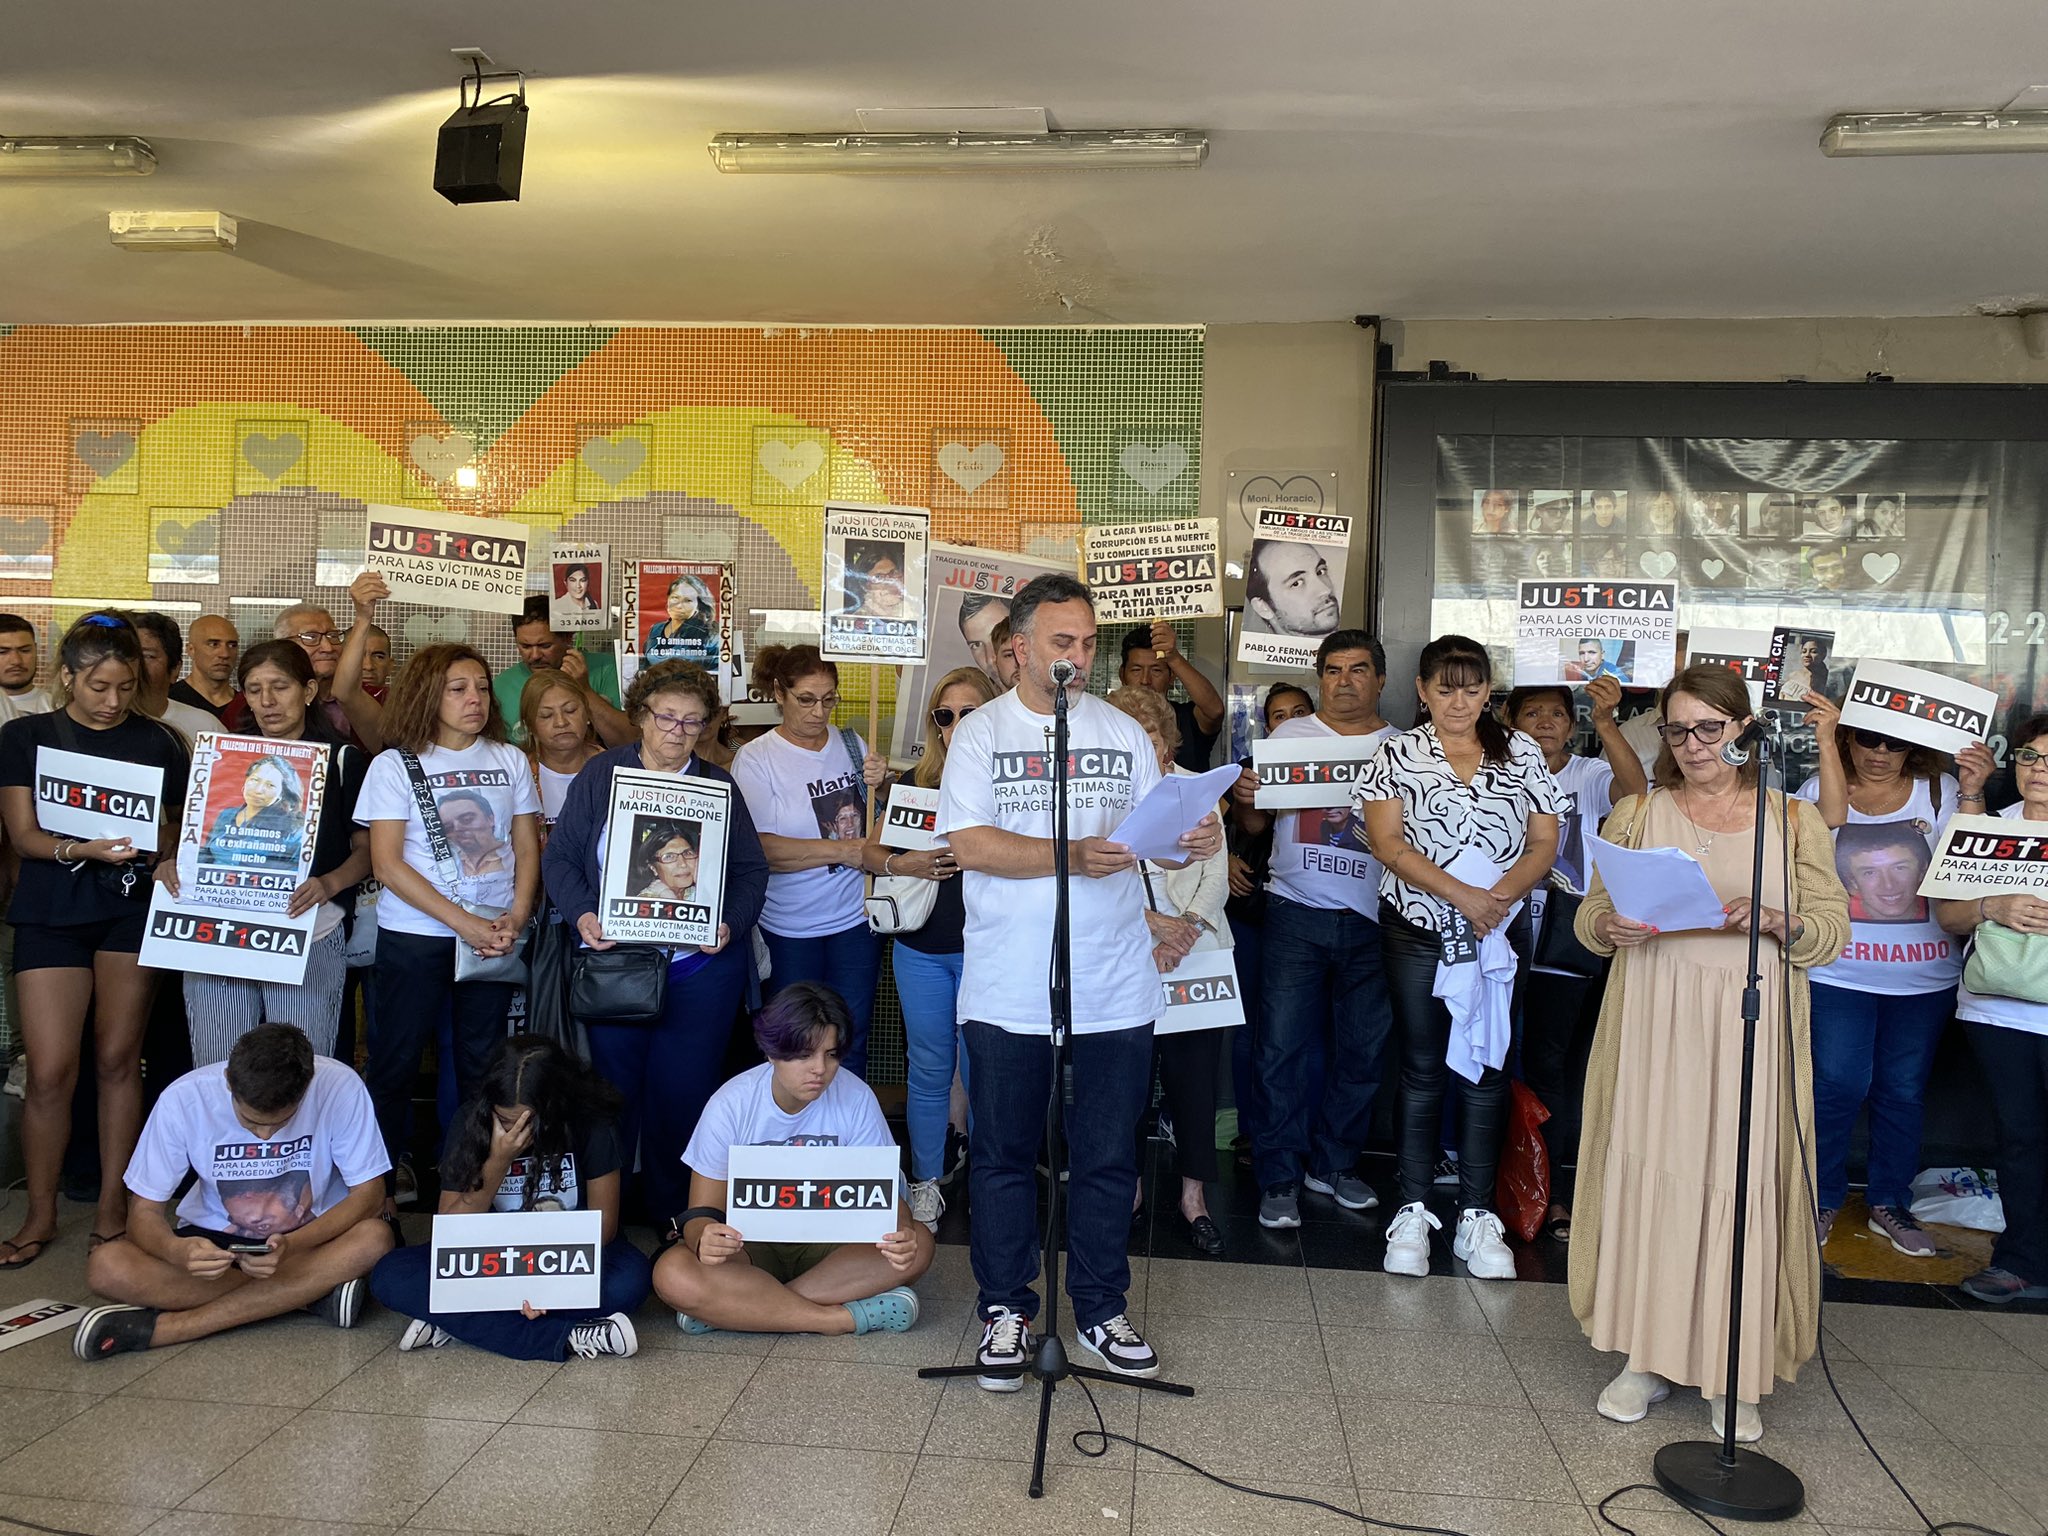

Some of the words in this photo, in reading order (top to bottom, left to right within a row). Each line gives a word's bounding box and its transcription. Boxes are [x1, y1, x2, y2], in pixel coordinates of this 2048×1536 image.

[1247, 495, 1272, 503] Moni,
[1275, 494, 1316, 503] Horacio,
[839, 516, 889, 527] JUSTICIA
[893, 521, 915, 529] PARA
[1113, 528, 1136, 536] CARA
[1139, 525, 1171, 533] VISIBLE
[1188, 522, 1198, 530] LA
[832, 526, 868, 537] MARIA
[872, 529, 922, 541] SCIDONE
[1091, 537, 1146, 548] CORRUPCIÓN
[1161, 535, 1172, 543] LA
[1175, 533, 1209, 541] MUERTE
[553, 550, 601, 558] TATIANA
[1108, 548, 1149, 558] COMPLICE
[1177, 544, 1216, 553] SILENCIO
[368, 554, 404, 567] PARA
[409, 559, 434, 571] LAS
[439, 562, 501, 579] VÍCTIMAS
[506, 571, 523, 582] DE
[935, 556, 968, 566] TRAGEDIA
[981, 563, 999, 571] ONCE
[388, 571, 457, 588] TRAGEDIA
[462, 579, 480, 590] DE
[485, 582, 522, 595] ONCE
[1091, 590, 1128, 600] PARA
[1133, 588, 1150, 596] MI
[1156, 584, 1213, 595] ESPOSA
[1113, 596, 1175, 608] TATIANA
[1180, 595, 1189, 603] Y
[1100, 610, 1117, 619] MI
[1123, 608, 1155, 618] HIJA
[1520, 615, 1553, 625] PARA
[1558, 616, 1582, 624] LAS
[1587, 613, 1650, 626] VÍCTIMAS
[1655, 617, 1672, 627] DE
[1519, 628, 1534, 637] LA
[1538, 628, 1606, 637] TRAGEDIA
[1610, 629, 1627, 638] DE
[1632, 630, 1670, 640] ONCE
[657, 637, 666, 646] Te
[668, 637, 702, 646] amamos
[1245, 643, 1275, 652] PABLO
[1266, 655, 1308, 665] ZANOTTI
[1023, 784, 1047, 795] LAS
[1118, 783, 1131, 795] DE
[628, 790, 686, 804] JUSTICIA
[691, 799, 715, 809] PARA
[1076, 797, 1094, 808] DE
[1100, 796, 1127, 810] ONCE
[619, 801, 661, 813] MARIA
[666, 805, 723, 822] SCIDONE
[224, 825, 237, 834] Te
[238, 826, 281, 838] amamos
[227, 839, 286, 852] extrañamos
[232, 853, 266, 863] mucho
[1303, 847, 1367, 879] FEDE
[1940, 859, 1977, 870] PARA
[1981, 862, 2009, 871] LAS
[1935, 872, 1951, 880] LA
[1957, 874, 2028, 886] TRAGEDIA
[205, 896, 250, 906] TRAGEDIA
[240, 890, 279, 899] VÍCTIMAS
[634, 920, 650, 928] LAS
[653, 921, 694, 931] VÍCTIMAS
[621, 930, 665, 938] TRAGEDIA
[684, 934, 709, 942] ONCE
[262, 1153, 300, 1167] VÍCTIMAS
[227, 1169, 274, 1177] TRAGEDIA
[277, 1166, 287, 1174] DE
